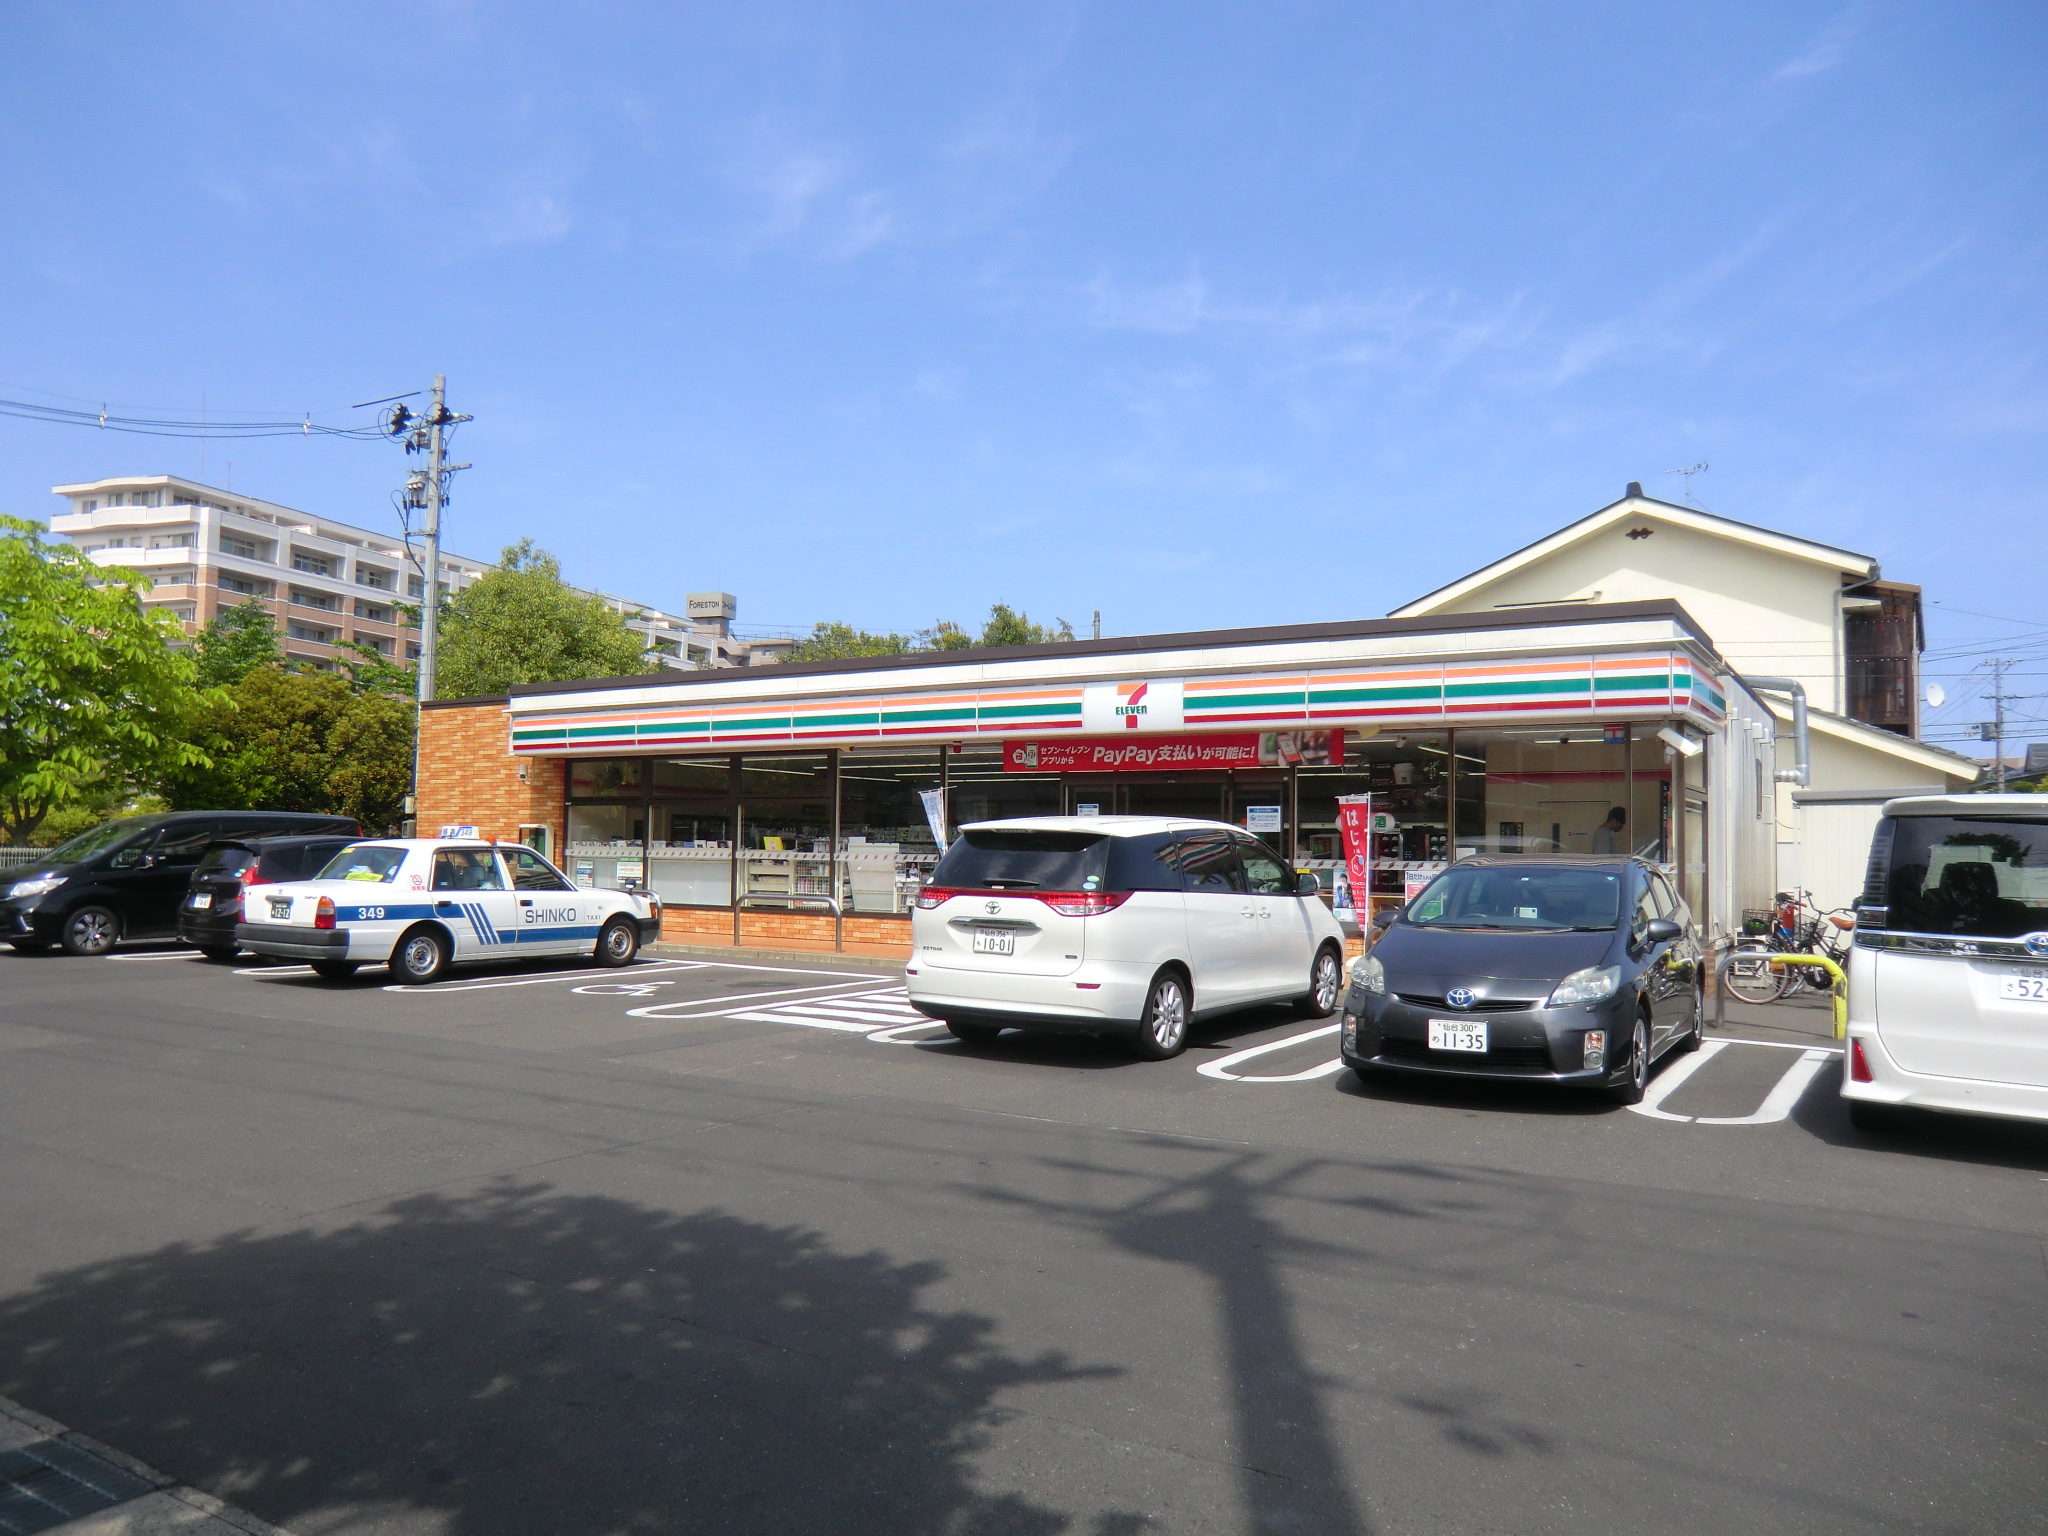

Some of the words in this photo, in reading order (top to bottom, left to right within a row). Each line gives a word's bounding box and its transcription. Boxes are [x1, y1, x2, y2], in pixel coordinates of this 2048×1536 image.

[689, 600, 719, 609] FORESTON
[1041, 757, 1074, 765] アプリから
[1374, 815, 1387, 828] 酒
[274, 908, 290, 918] 12-12
[358, 907, 385, 919] 349
[525, 908, 577, 924] SHINKO
[984, 937, 1011, 951] 10-01
[1443, 1032, 1484, 1049] 11-35
